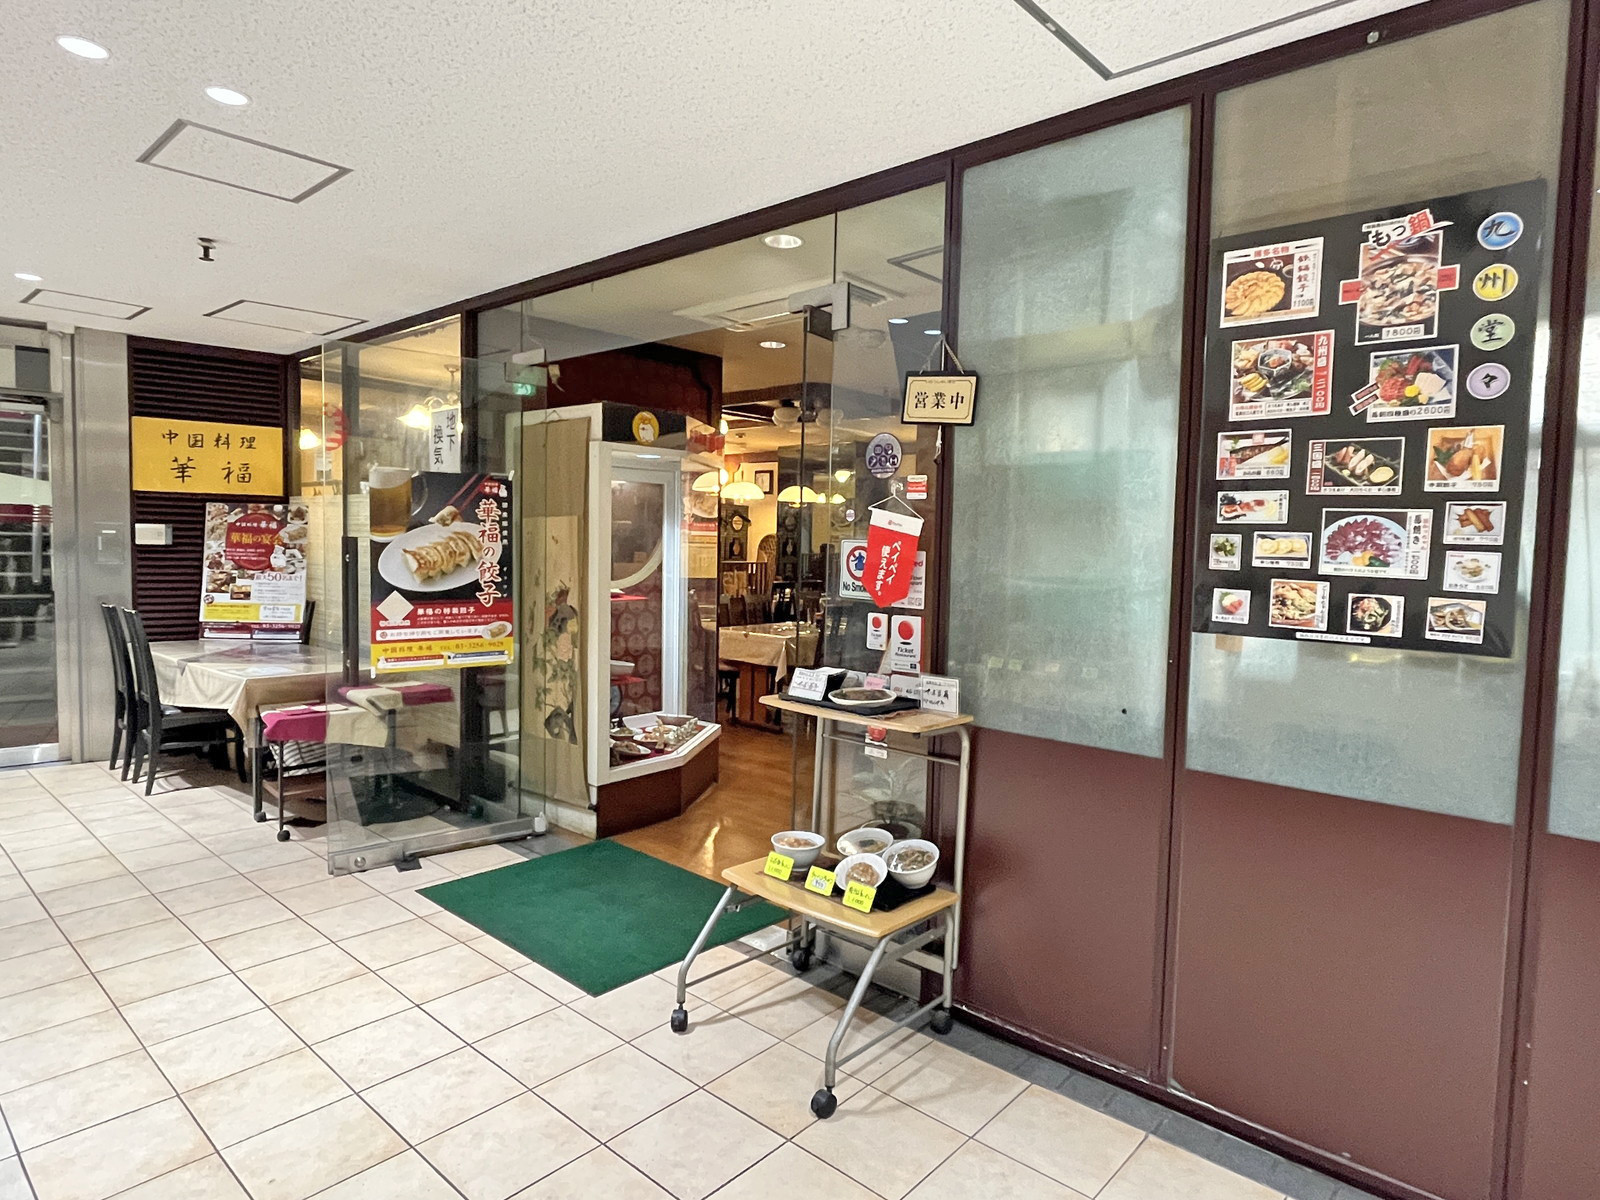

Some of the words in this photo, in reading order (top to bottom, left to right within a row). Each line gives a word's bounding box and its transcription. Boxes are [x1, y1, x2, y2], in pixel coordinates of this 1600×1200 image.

[1370, 210, 1432, 247] もつ鍋
[1385, 327, 1421, 337] 1800円
[914, 391, 965, 410] 営業中
[162, 430, 257, 450] 中国料理
[170, 457, 252, 484] 華福
[231, 532, 284, 545] 華福の宴会
[475, 499, 502, 606] 華福の餃子
[886, 540, 902, 585] ペイペイ
[875, 545, 891, 596] 使えます。
[843, 582, 851, 591] No
